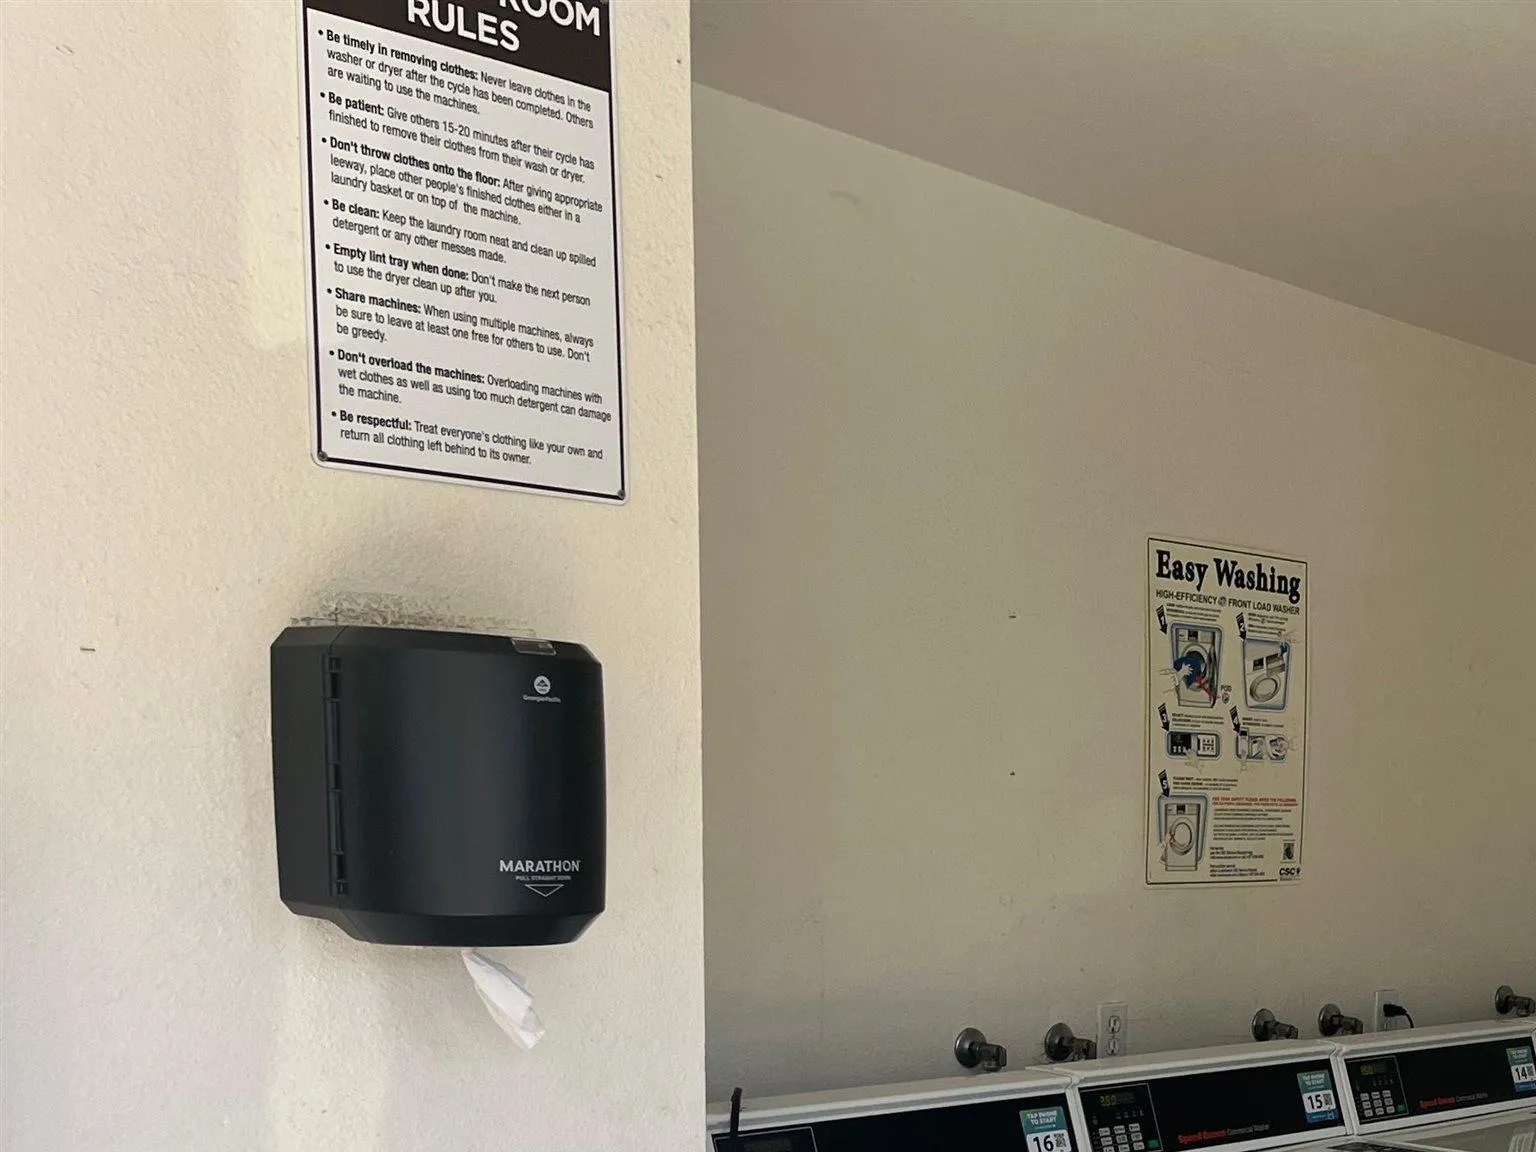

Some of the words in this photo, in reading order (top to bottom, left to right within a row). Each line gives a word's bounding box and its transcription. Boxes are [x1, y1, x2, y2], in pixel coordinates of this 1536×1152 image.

[407, 0, 520, 51] RULES
[326, 28, 341, 44] Be
[342, 33, 375, 55] timely
[377, 42, 388, 56] in
[390, 48, 438, 71] removing
[439, 61, 478, 81] clothes:
[480, 70, 507, 88] Never
[508, 78, 532, 96] leave
[534, 87, 565, 105] clothes
[566, 94, 576, 108] in
[577, 98, 591, 112] the
[327, 66, 344, 79] are
[345, 71, 382, 91] waiting
[383, 78, 394, 92] to
[395, 83, 413, 99] use
[415, 87, 431, 102] the
[433, 93, 480, 114] machines.
[328, 91, 343, 106] Be
[344, 98, 385, 116] patient:
[386, 106, 408, 122] Give
[409, 113, 440, 130] others
[442, 120, 471, 138] 15-20
[472, 130, 509, 147] minutes
[510, 139, 531, 153] after
[532, 144, 554, 159] their
[555, 151, 577, 165] cycle
[578, 155, 595, 170] has
[329, 136, 358, 154] Don't
[360, 143, 391, 161] throw
[392, 152, 430, 171] clothes
[432, 162, 455, 176] onto
[456, 166, 473, 181] the
[474, 170, 501, 188] floor:
[502, 177, 524, 193] After
[525, 184, 553, 202] giving
[554, 193, 603, 212] appropriate
[331, 197, 346, 212] Be
[348, 202, 380, 219] clean:
[381, 208, 407, 227] Keep
[408, 215, 424, 229] the
[426, 219, 461, 239] laundry
[463, 229, 487, 243] room
[489, 233, 510, 248] neat
[511, 240, 528, 252] and
[530, 243, 554, 257] clean
[555, 250, 567, 262] up
[568, 253, 596, 267] spilled
[333, 242, 367, 262] Empty
[368, 249, 387, 264] lint
[388, 253, 409, 271] tray
[411, 260, 439, 276] when
[441, 265, 469, 281] done:
[471, 270, 496, 287] Don't
[497, 278, 523, 292] make
[524, 282, 539, 296] the
[540, 287, 560, 300] next
[561, 292, 591, 306] person
[334, 287, 366, 304] Share
[368, 295, 421, 314] machines:
[423, 303, 451, 319] When
[452, 311, 478, 327] using
[479, 316, 516, 332] multiple
[517, 324, 562, 342] machines,
[564, 332, 594, 348] always
[336, 321, 349, 335] be
[351, 325, 387, 343] greedy.
[337, 348, 366, 365] Don't
[368, 356, 413, 372] overload
[415, 362, 432, 375] the
[434, 367, 485, 384] machines:
[486, 374, 539, 395] Overloading
[541, 385, 582, 401] machines
[584, 392, 603, 404] with
[338, 383, 355, 397] the
[357, 386, 401, 403] machine.
[339, 409, 354, 423] Be
[356, 414, 412, 431] respectful:
[414, 420, 439, 435] Treat
[440, 427, 490, 443] everyone's
[491, 433, 527, 450] clothing
[528, 437, 544, 451] like
[546, 442, 565, 454] your
[567, 445, 586, 456] own
[587, 448, 603, 460] and
[1156, 549, 1208, 591] Easy
[1213, 557, 1301, 604] Washing
[1156, 590, 1218, 605] HIGH-EFFICIENCY
[1228, 599, 1252, 609] FRONT
[1253, 602, 1271, 611] LOAD
[1273, 604, 1300, 615] WASHER
[500, 859, 580, 873] MARATHON
[1514, 1067, 1528, 1081] 14
[1307, 1094, 1324, 1109] 15
[1033, 1134, 1055, 1152] 16
